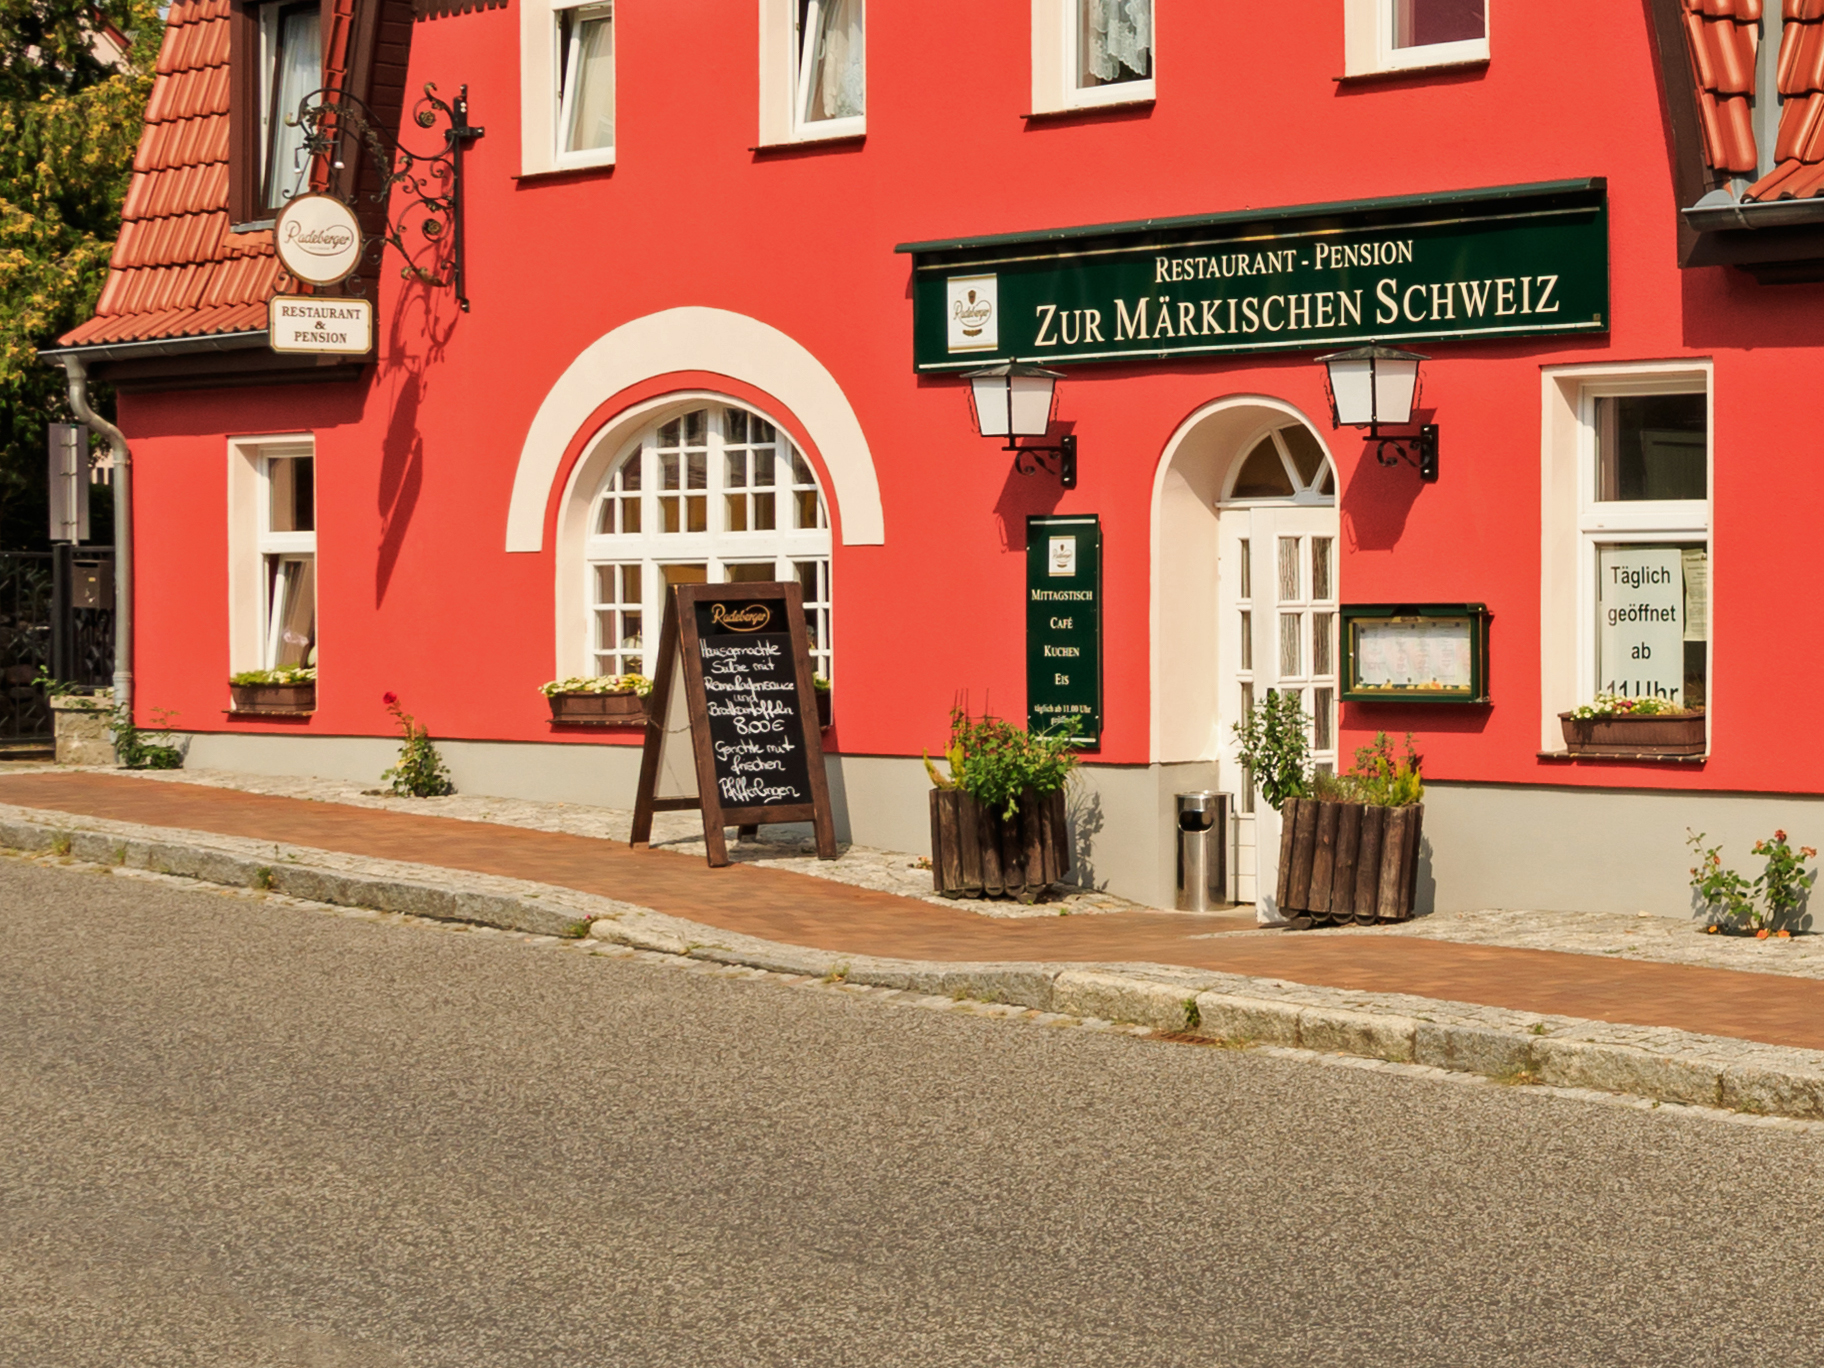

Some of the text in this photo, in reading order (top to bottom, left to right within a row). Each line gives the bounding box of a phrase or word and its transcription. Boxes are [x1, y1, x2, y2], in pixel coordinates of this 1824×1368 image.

[284, 220, 354, 257] Radeberger
[1155, 249, 1297, 283] RESTAURANT
[1314, 239, 1414, 270] PENSION
[281, 306, 362, 320] RESTAURANT
[1034, 274, 1560, 347] ZUR MÄRKISCHEN SCHWEIZ
[314, 321, 326, 330] &
[294, 331, 347, 344] PENSION
[1610, 566, 1670, 589] Täglich
[1031, 589, 1093, 600] MITTAGSTISCH
[711, 603, 771, 632] Radeberger
[1608, 603, 1676, 627] geöffnet
[699, 638, 781, 662] Hausgemachte
[1044, 644, 1080, 657] KUCHEN
[1631, 642, 1651, 660] ab
[752, 657, 775, 671] mit
[733, 692, 758, 703] und
[715, 734, 795, 761] Gerichte mit
[731, 754, 786, 775] frischen
